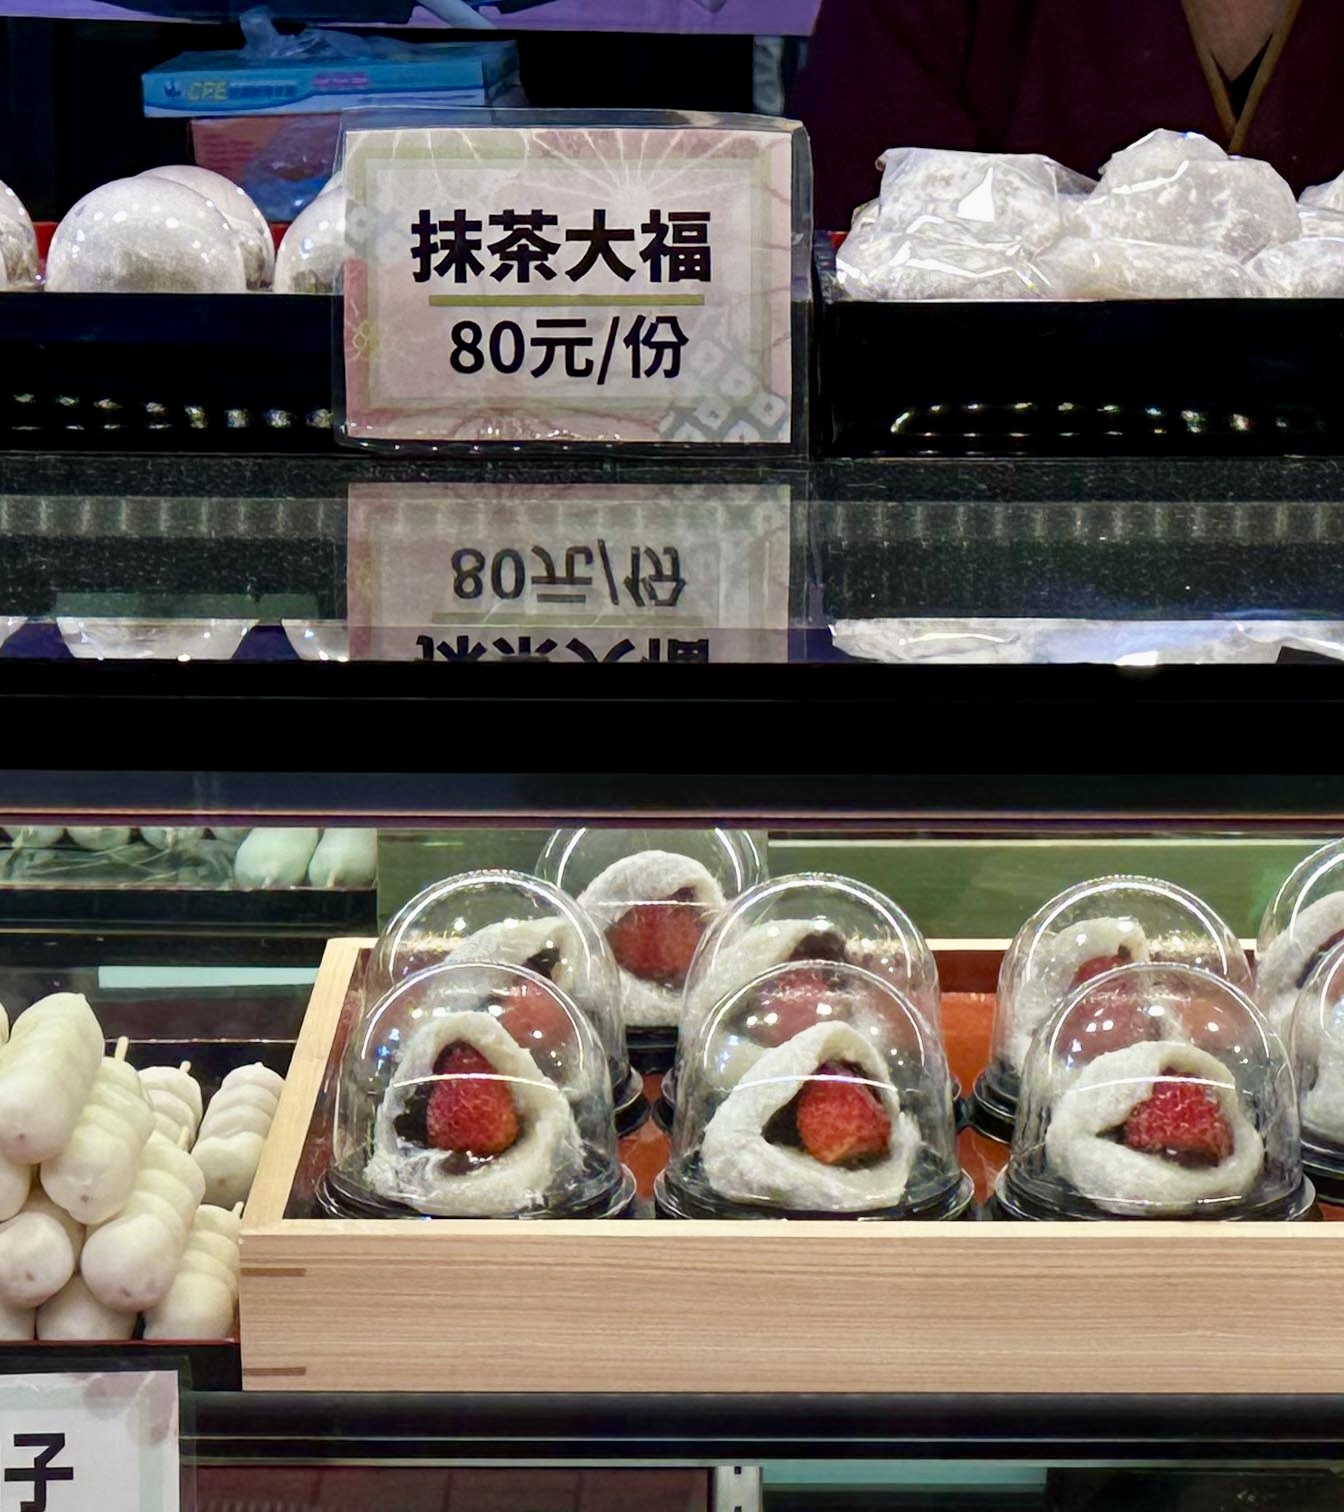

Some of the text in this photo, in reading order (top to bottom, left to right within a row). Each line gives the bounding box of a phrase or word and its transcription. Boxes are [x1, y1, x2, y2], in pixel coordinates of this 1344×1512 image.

[411, 209, 712, 284] 抹茶大福
[449, 315, 690, 385] 80元/份
